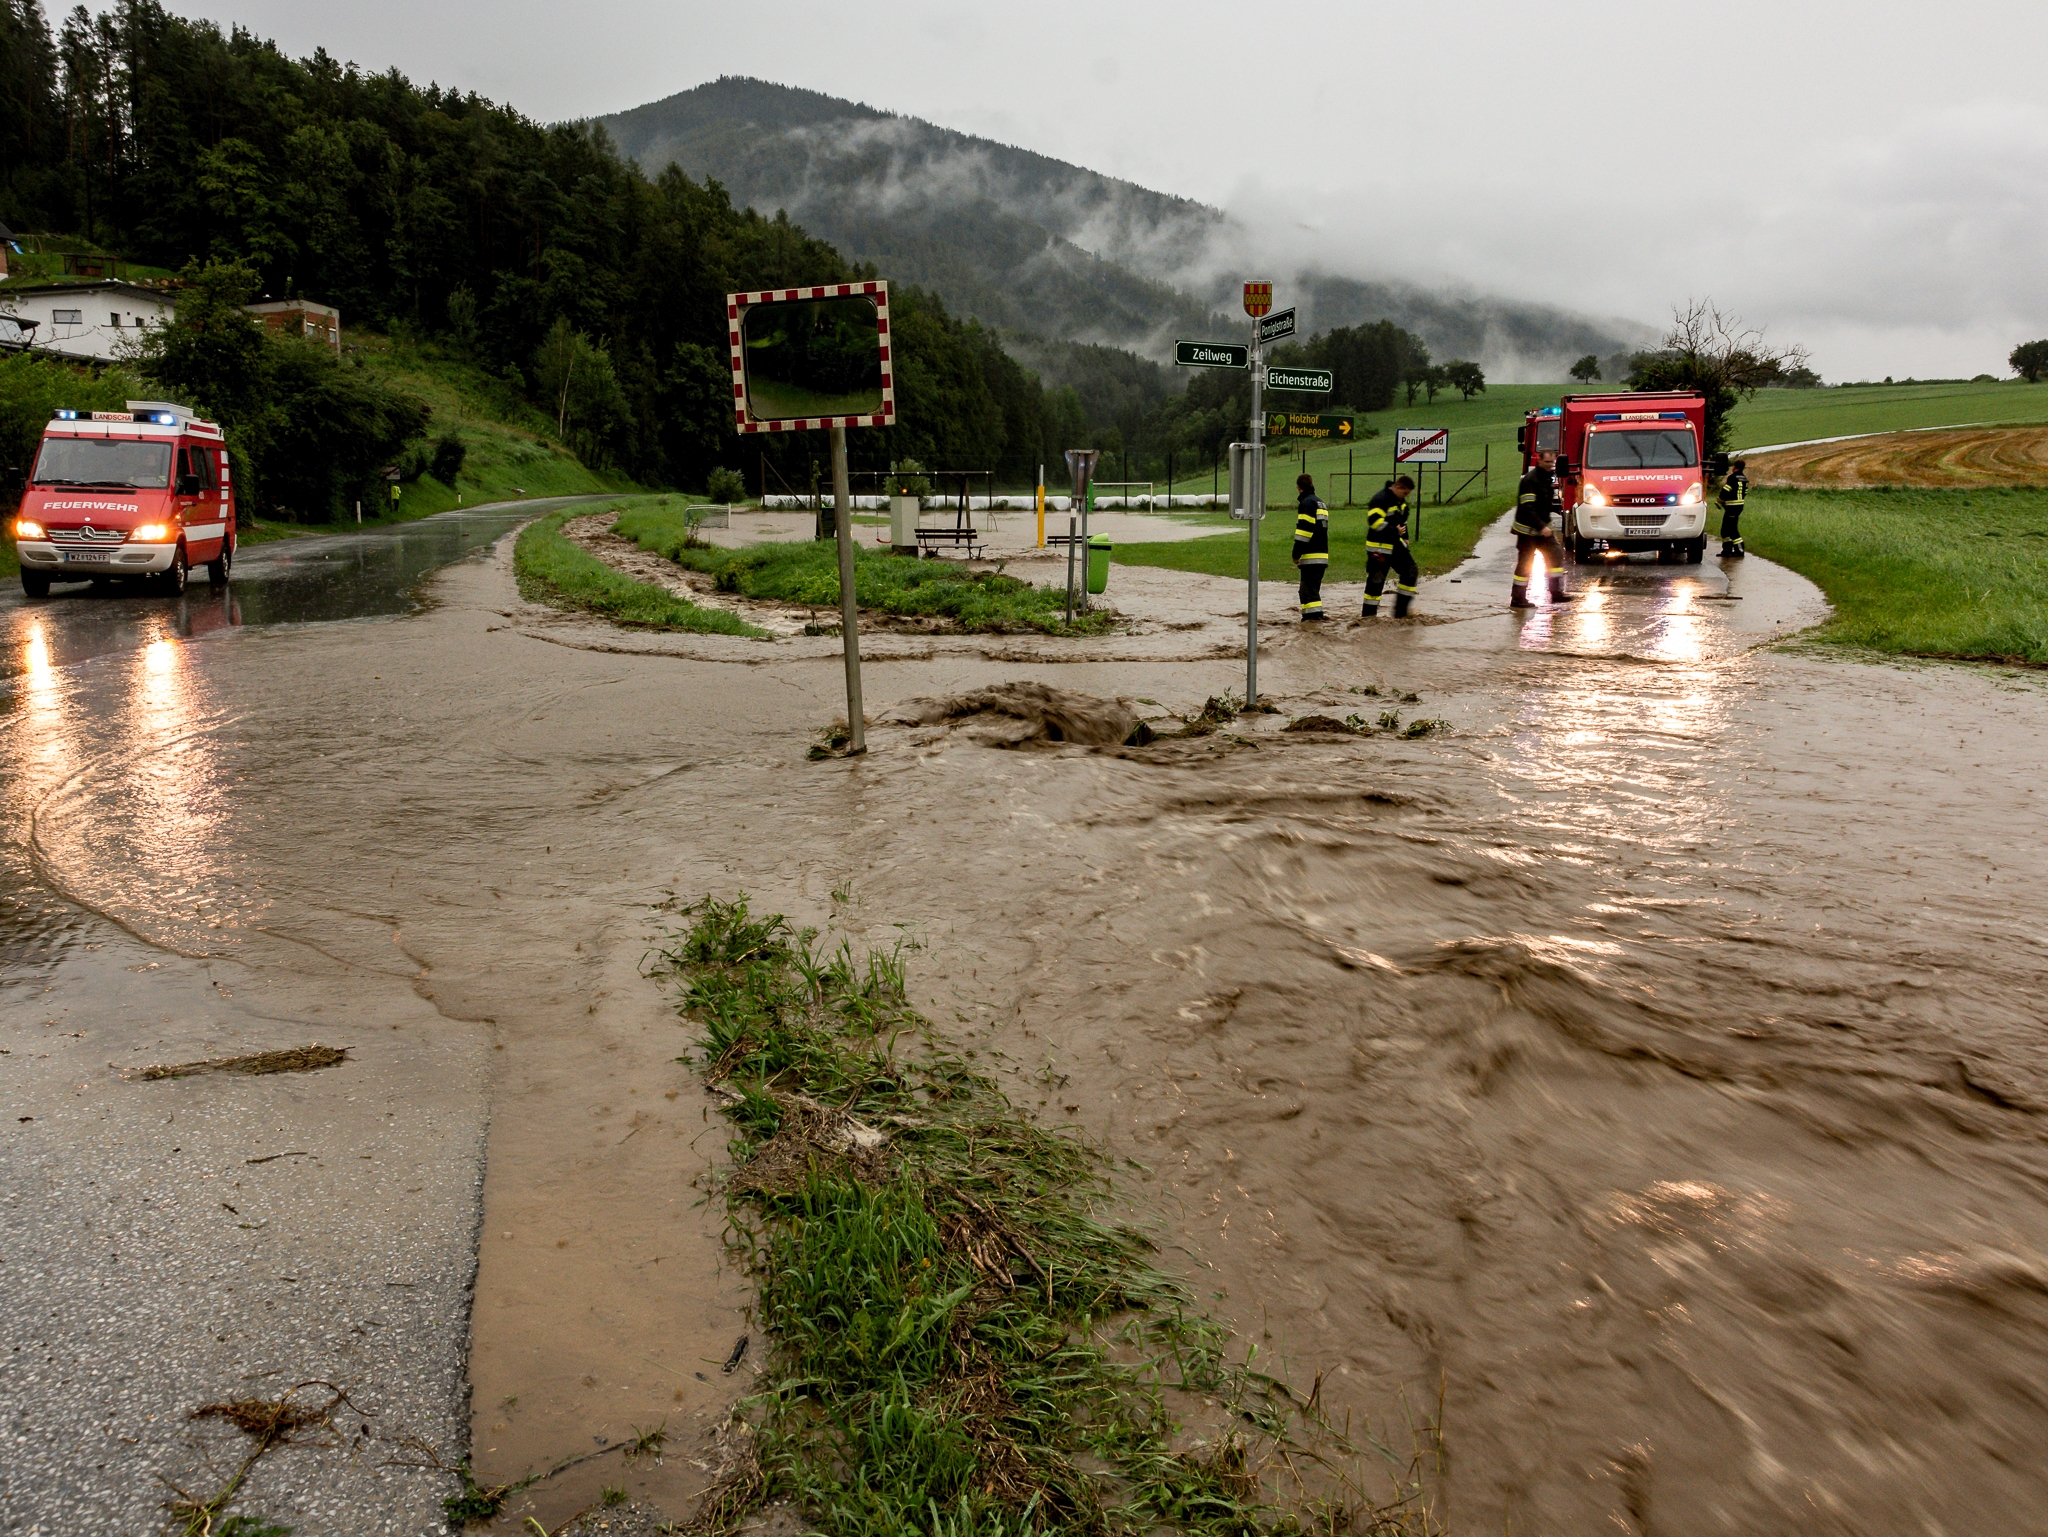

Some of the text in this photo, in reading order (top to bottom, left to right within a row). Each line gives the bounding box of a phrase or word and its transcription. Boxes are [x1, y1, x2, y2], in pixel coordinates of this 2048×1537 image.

[1261, 316, 1293, 337] Poniglstraße
[1192, 348, 1232, 365] Zeilweg
[1269, 372, 1329, 388] Eichenstraße
[94, 413, 131, 421] LANDSCHA
[1289, 413, 1319, 424] Holzhof
[1289, 425, 1330, 438] Hochegger
[1602, 474, 1683, 482] FEUERWEHR
[43, 501, 139, 513] FEUERWEHR
